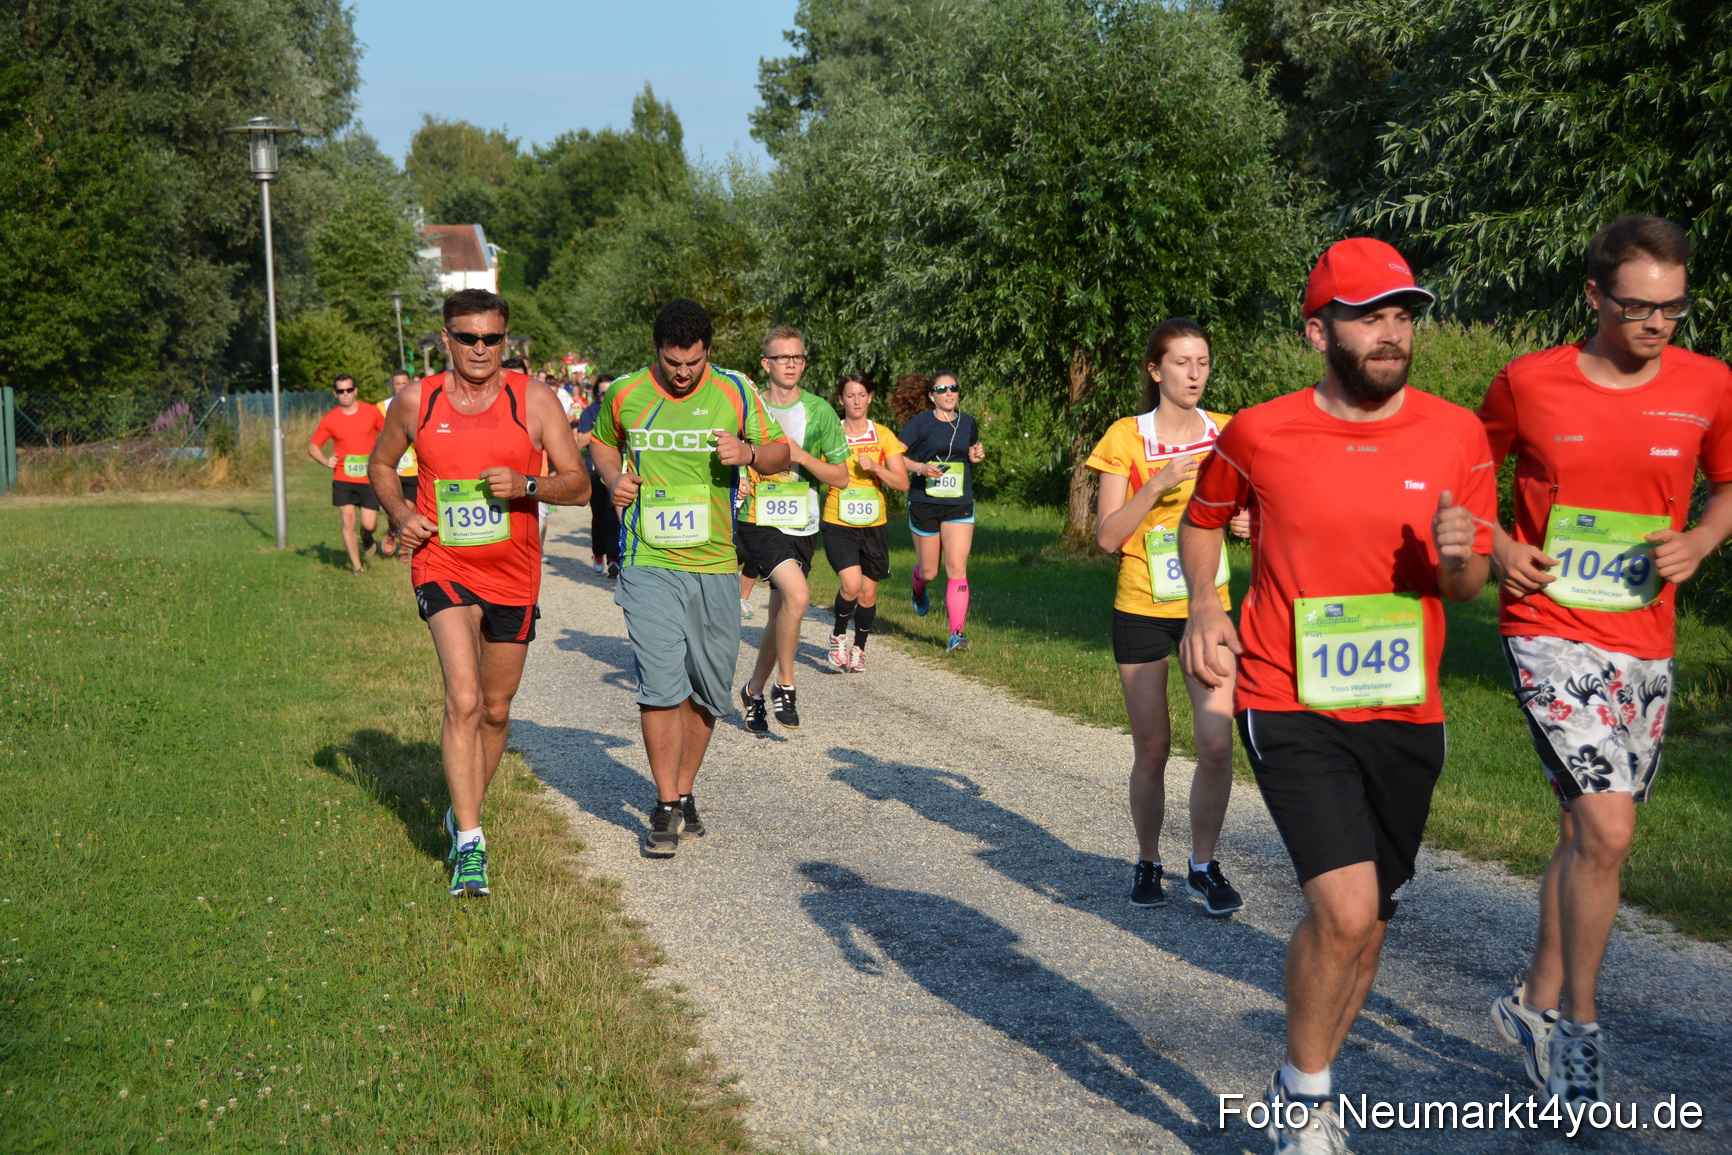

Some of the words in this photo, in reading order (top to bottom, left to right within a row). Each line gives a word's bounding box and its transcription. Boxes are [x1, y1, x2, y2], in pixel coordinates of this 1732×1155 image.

[629, 428, 725, 452] BOCK
[1563, 434, 1584, 442] JAKO
[857, 445, 880, 454] BÖGL
[1649, 446, 1679, 457] Sascha
[933, 476, 957, 488] 860
[1403, 480, 1425, 490] Timo
[766, 500, 798, 515] 985
[847, 502, 873, 515] 936
[444, 504, 502, 528] 1390
[655, 510, 695, 531] 141
[1556, 547, 1650, 587] 1049
[1316, 613, 1361, 625] firmenlauf
[1312, 638, 1411, 678] 1048
[1330, 684, 1349, 693] Timo
[1350, 682, 1392, 691] Wolfsteiner
